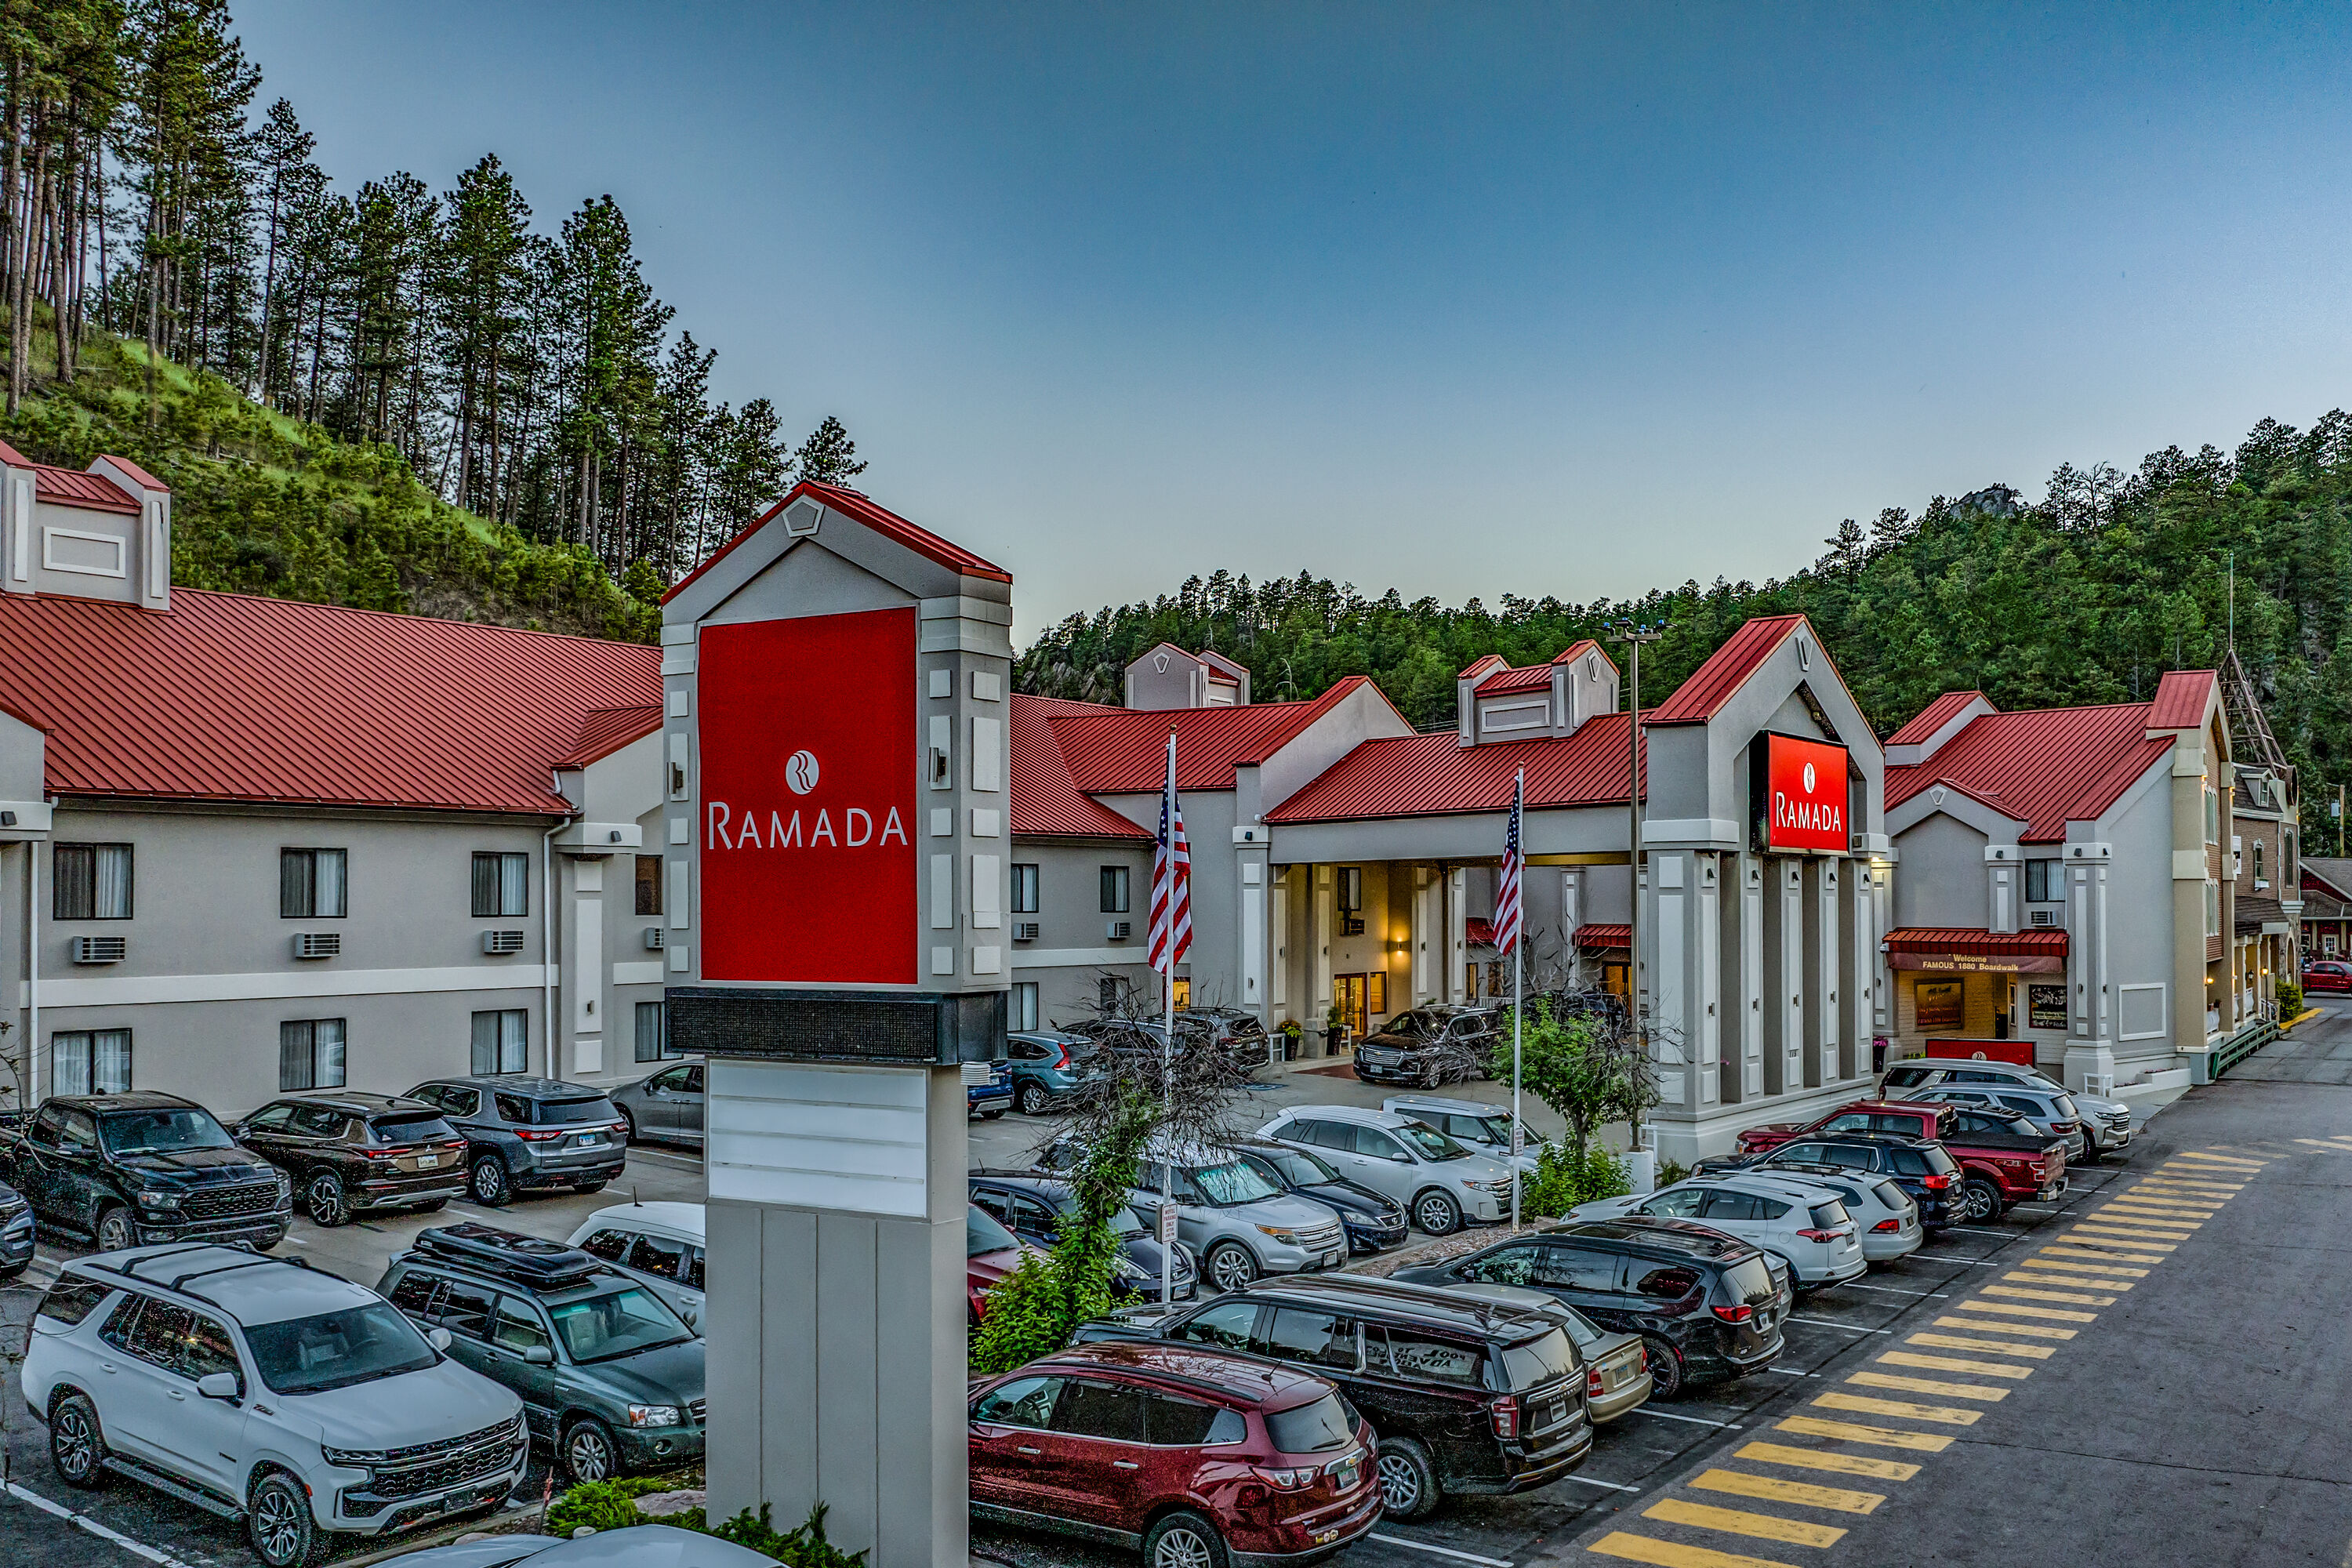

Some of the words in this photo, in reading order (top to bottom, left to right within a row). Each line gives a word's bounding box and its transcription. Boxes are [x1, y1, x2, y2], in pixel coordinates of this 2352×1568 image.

[1776, 791, 1842, 832] RAMADA
[708, 801, 908, 849] RAMADA
[1953, 953, 1987, 963] Welcome
[1979, 963, 2019, 971] Boardwalk
